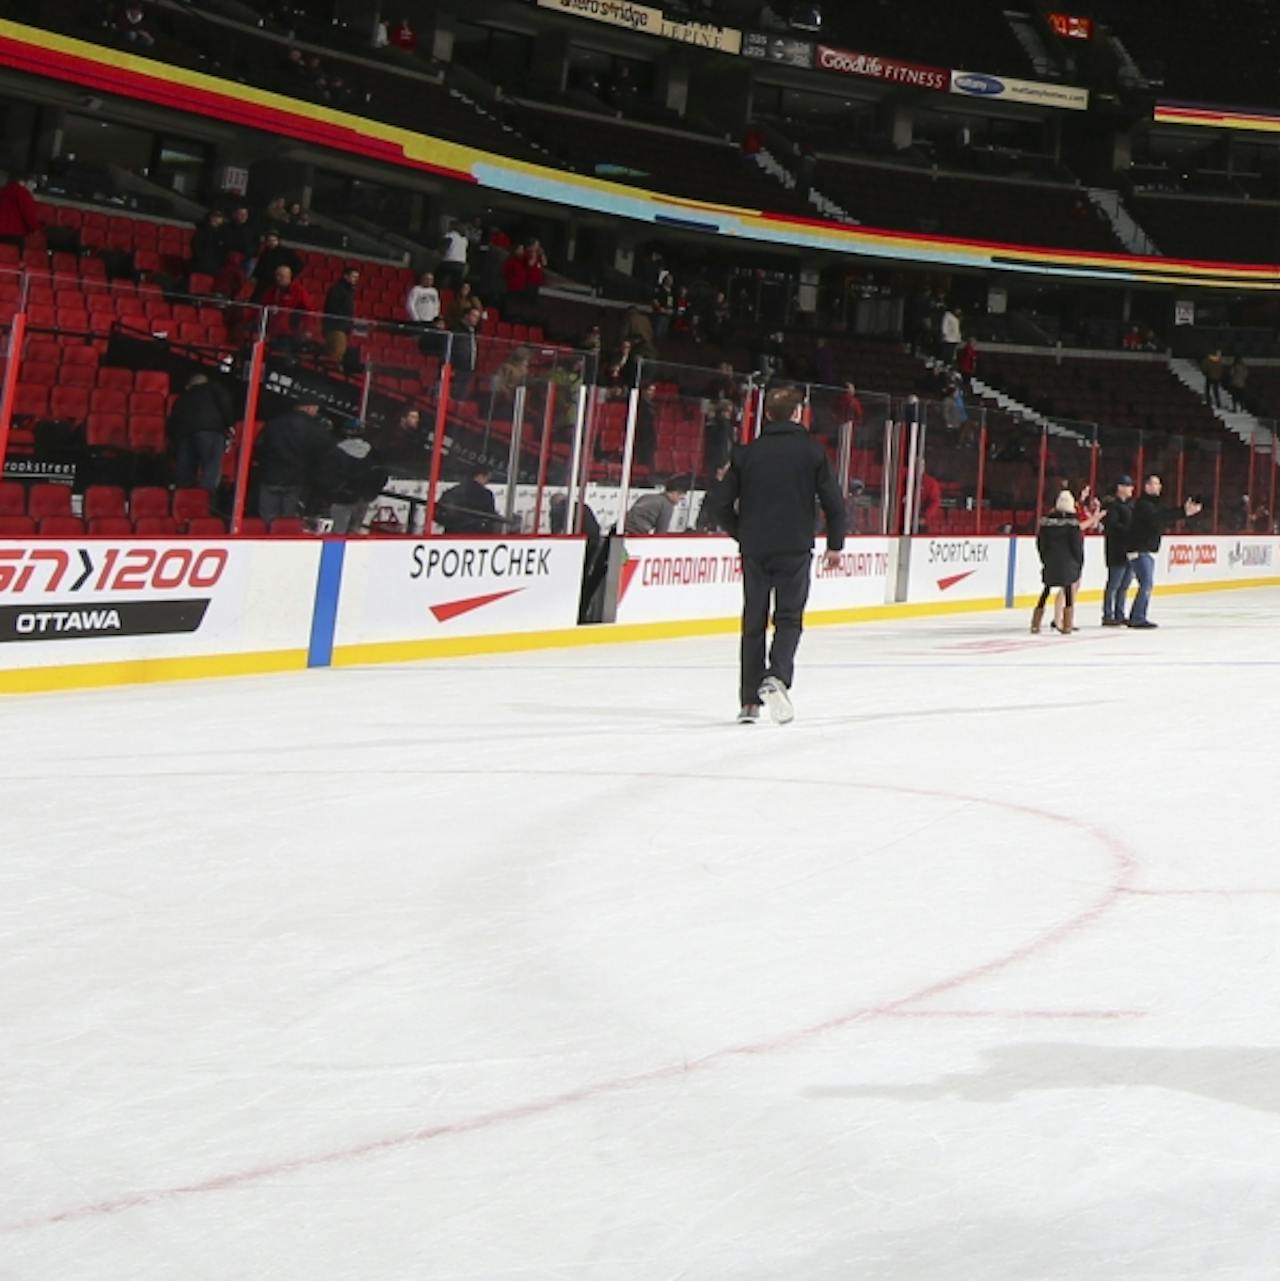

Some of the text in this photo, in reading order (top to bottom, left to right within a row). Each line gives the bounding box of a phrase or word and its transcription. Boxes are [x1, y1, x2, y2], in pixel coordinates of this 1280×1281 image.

[819, 47, 883, 77] GoodLife
[884, 65, 944, 90] FITNESS
[1, 460, 77, 474] rookstreet
[642, 556, 744, 587] CANADIAN TIR
[16, 610, 121, 634] OTTAWA
